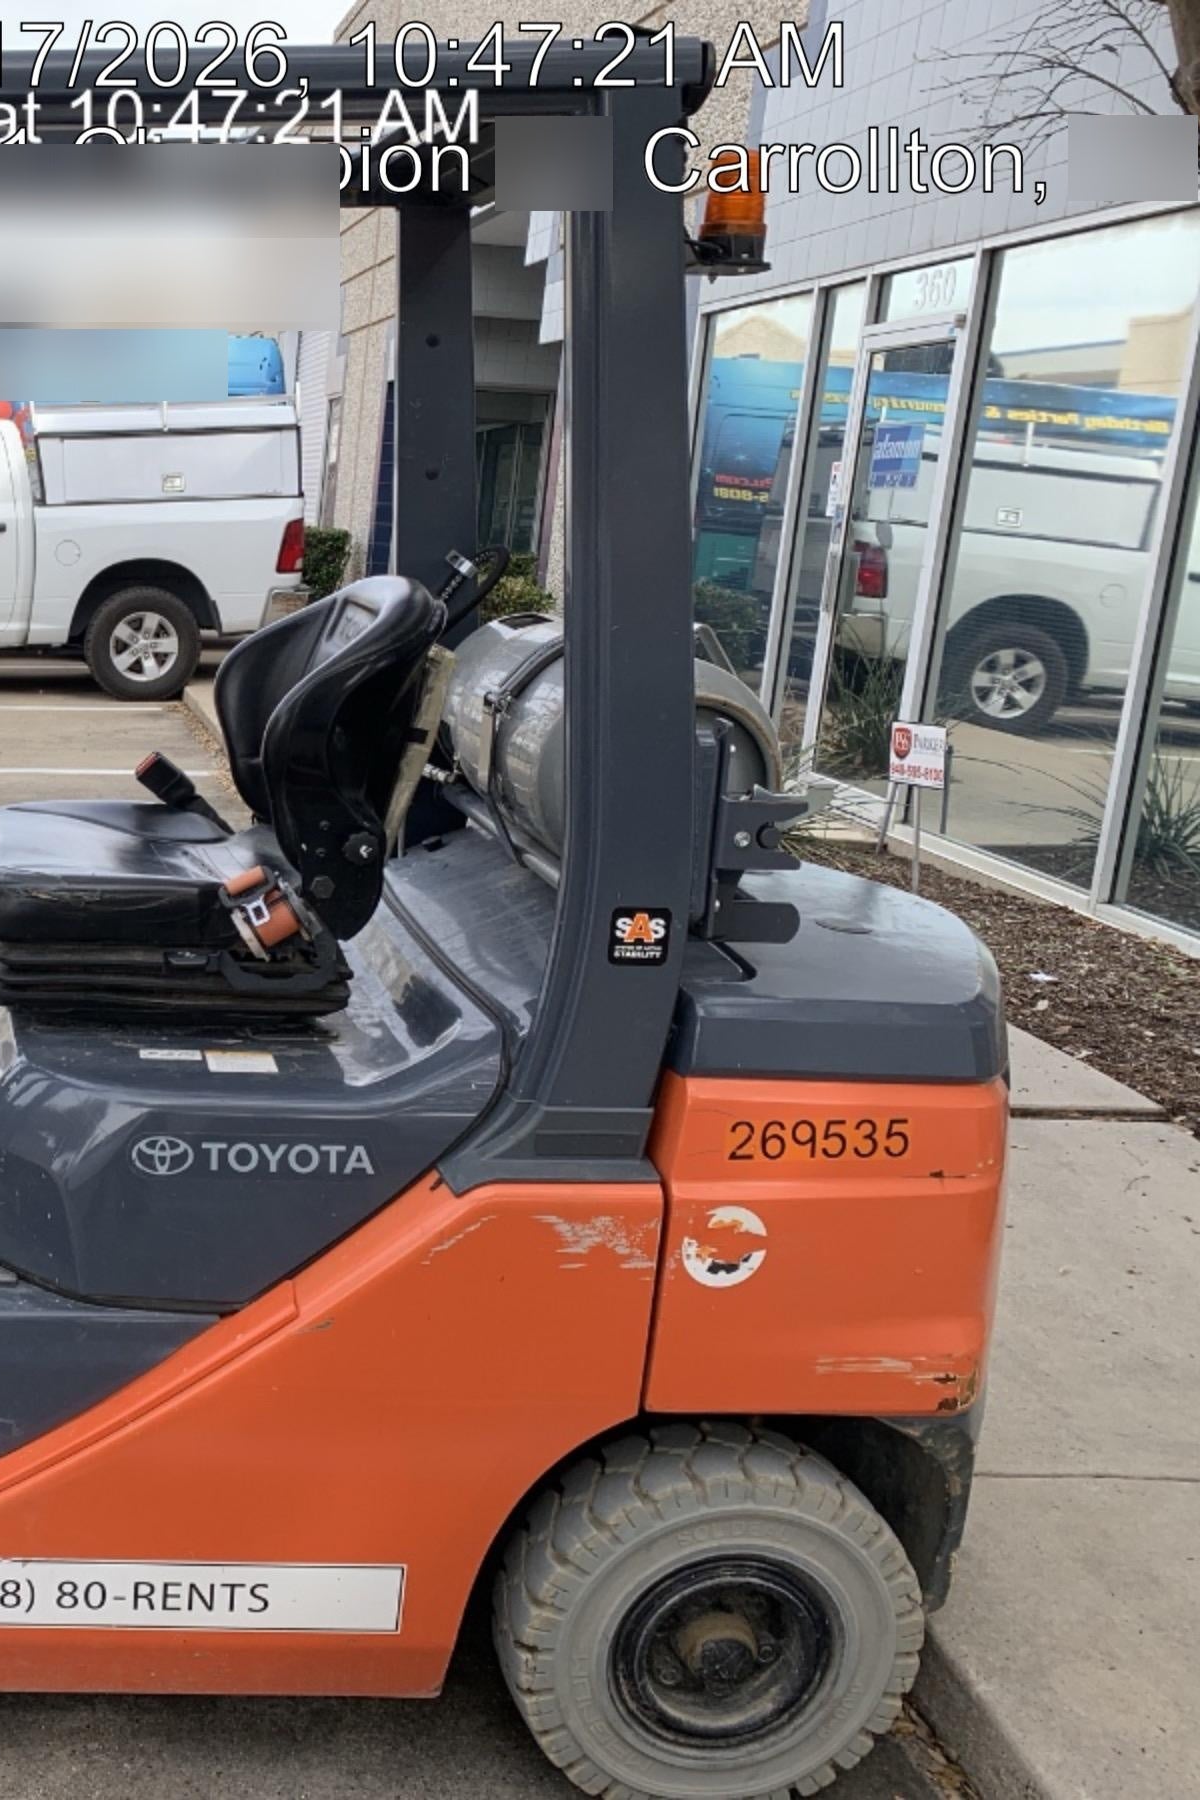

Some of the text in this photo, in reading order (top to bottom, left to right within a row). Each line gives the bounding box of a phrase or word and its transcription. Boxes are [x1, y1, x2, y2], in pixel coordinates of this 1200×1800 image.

[614, 913, 667, 943] SAS
[728, 1118, 911, 1161] 269535
[201, 1142, 376, 1175] TOYOTA
[55, 1578, 271, 1615] 80-RENTS
